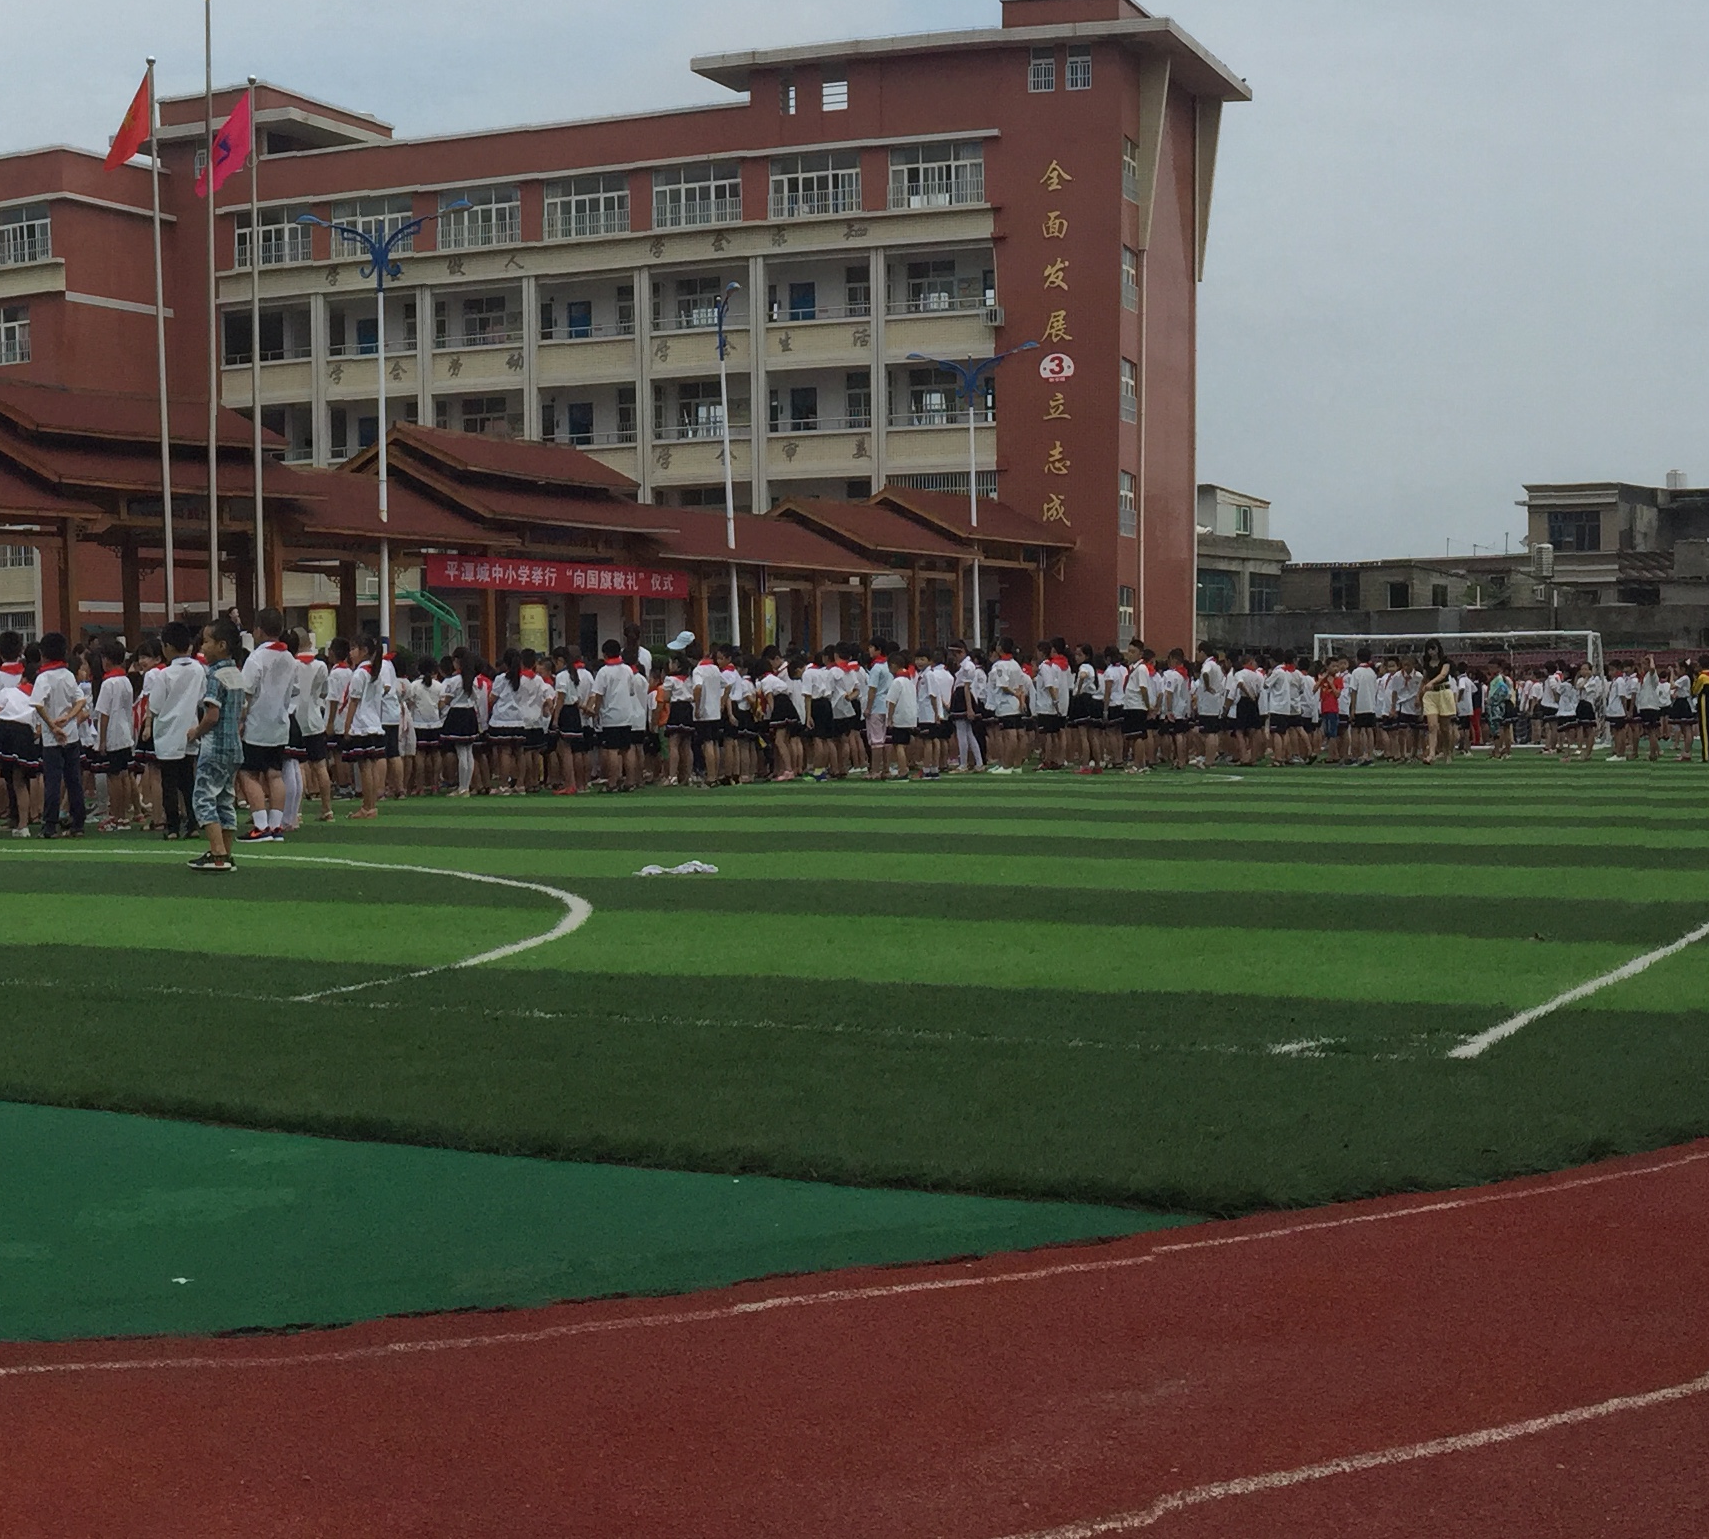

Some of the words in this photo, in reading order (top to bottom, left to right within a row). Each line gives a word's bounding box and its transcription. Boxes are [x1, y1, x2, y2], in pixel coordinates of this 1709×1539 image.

[325, 254, 525, 287] 学做人
[1049, 356, 1064, 375] 3
